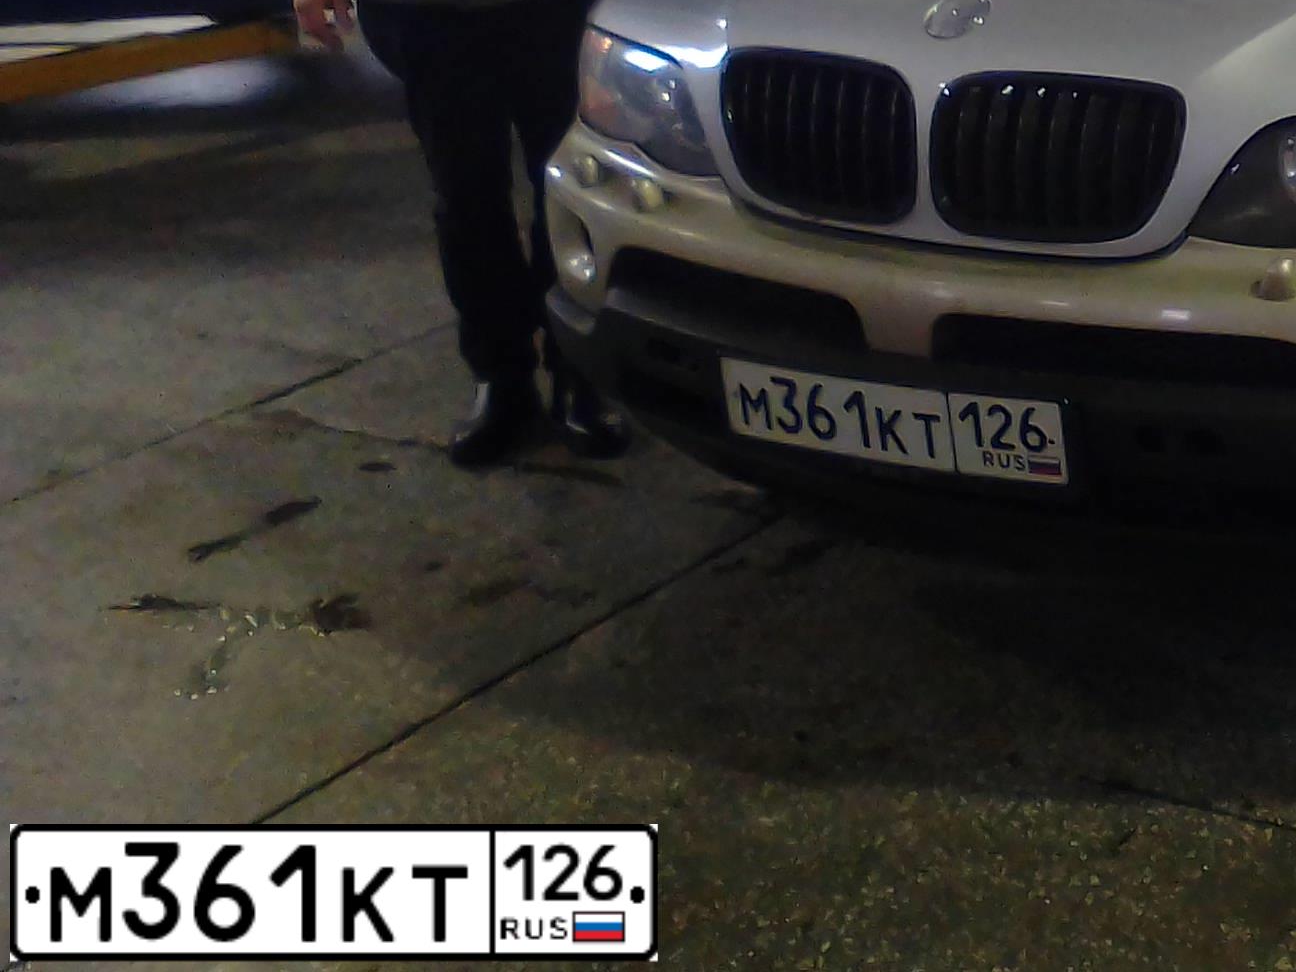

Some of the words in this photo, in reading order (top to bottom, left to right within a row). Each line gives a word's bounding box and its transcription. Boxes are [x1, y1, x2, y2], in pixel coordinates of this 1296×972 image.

[738, 376, 940, 459] M361KT
[958, 401, 1047, 453] 126
[982, 450, 1026, 471] RUS
